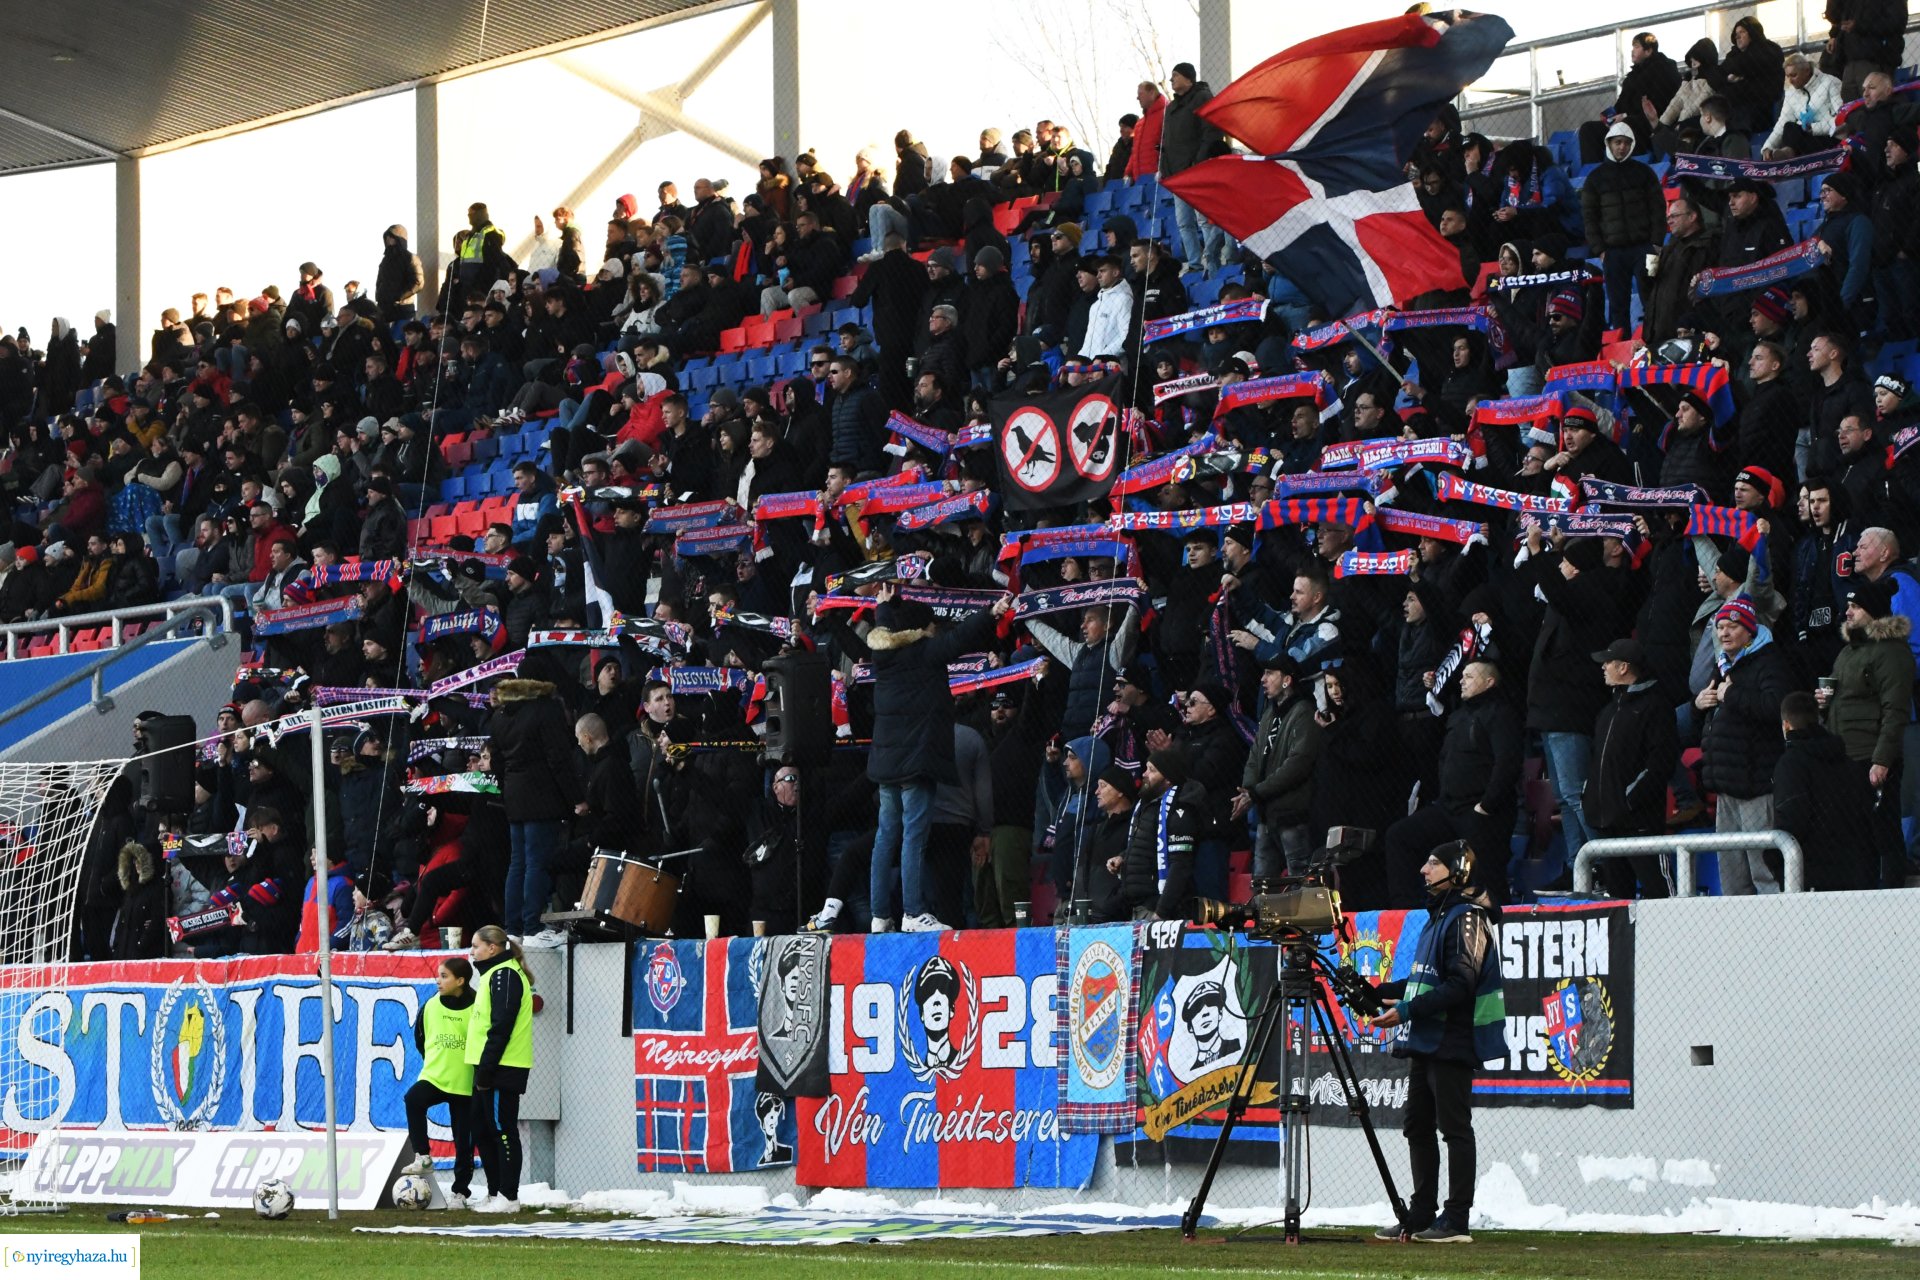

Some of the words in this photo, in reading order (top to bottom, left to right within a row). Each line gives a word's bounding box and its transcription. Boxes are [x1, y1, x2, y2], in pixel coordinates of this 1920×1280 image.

[827, 576, 844, 591] 024
[1836, 551, 1852, 577] C
[1493, 917, 1610, 979] STERN
[794, 934, 818, 1044] NYSFC
[814, 1085, 885, 1163] Vén
